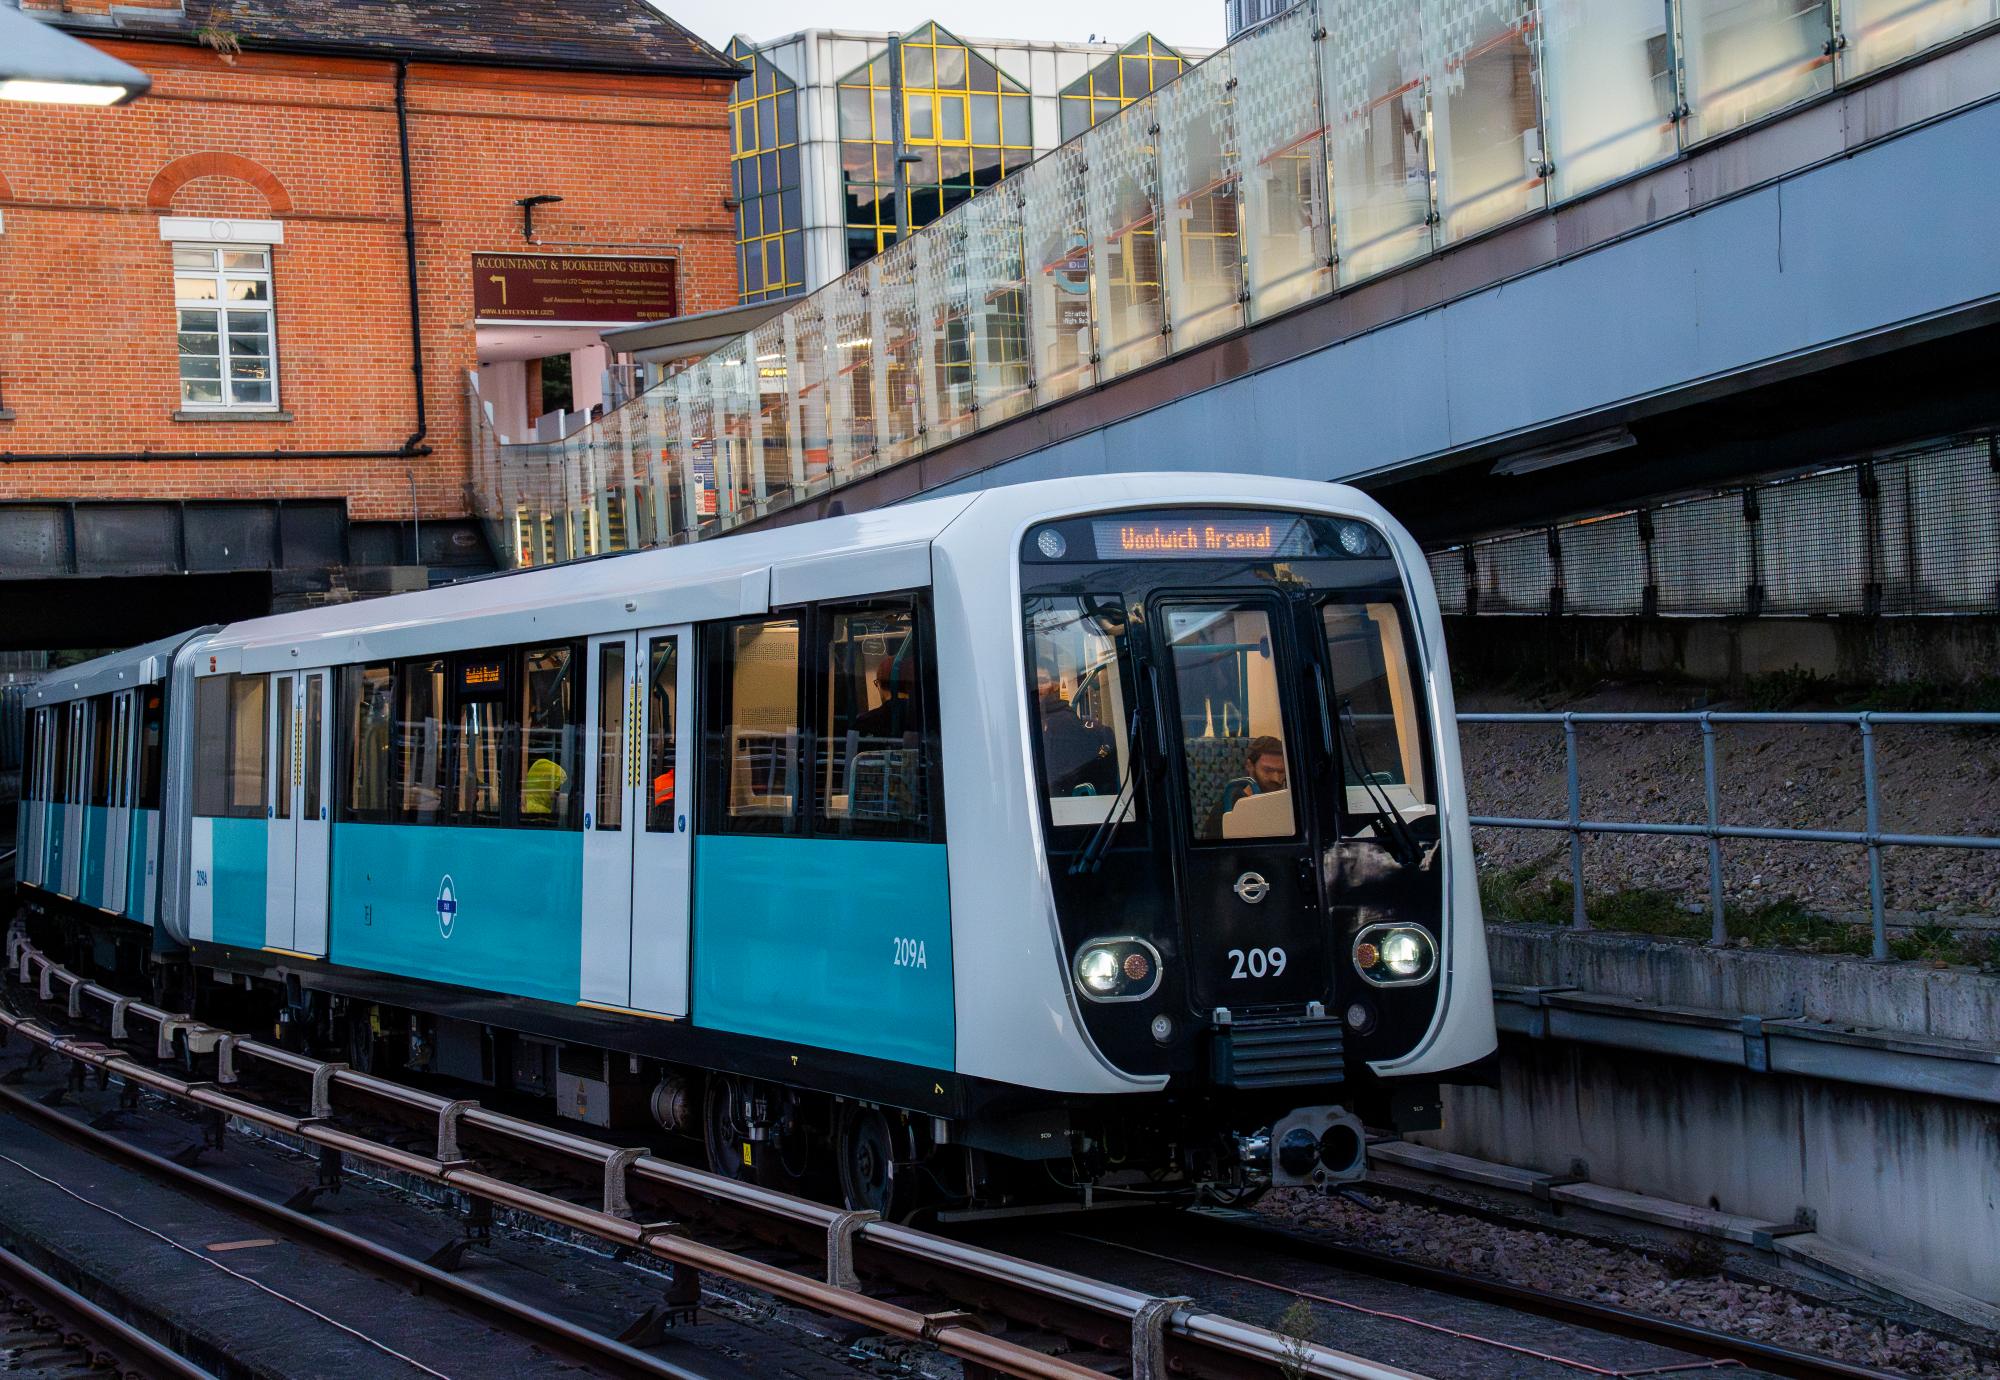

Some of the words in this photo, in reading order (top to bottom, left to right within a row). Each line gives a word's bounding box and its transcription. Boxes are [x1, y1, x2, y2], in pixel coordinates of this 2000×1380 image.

[476, 257, 547, 271] ACCOUNTANCY
[550, 260, 559, 271] &
[562, 260, 627, 273] BOOKKEEPING
[629, 262, 670, 274] SERVICES
[1121, 527, 1198, 550] Woolwich
[1205, 526, 1271, 549] Arsenal
[893, 936, 927, 969] 209A
[1228, 947, 1287, 979] 209
